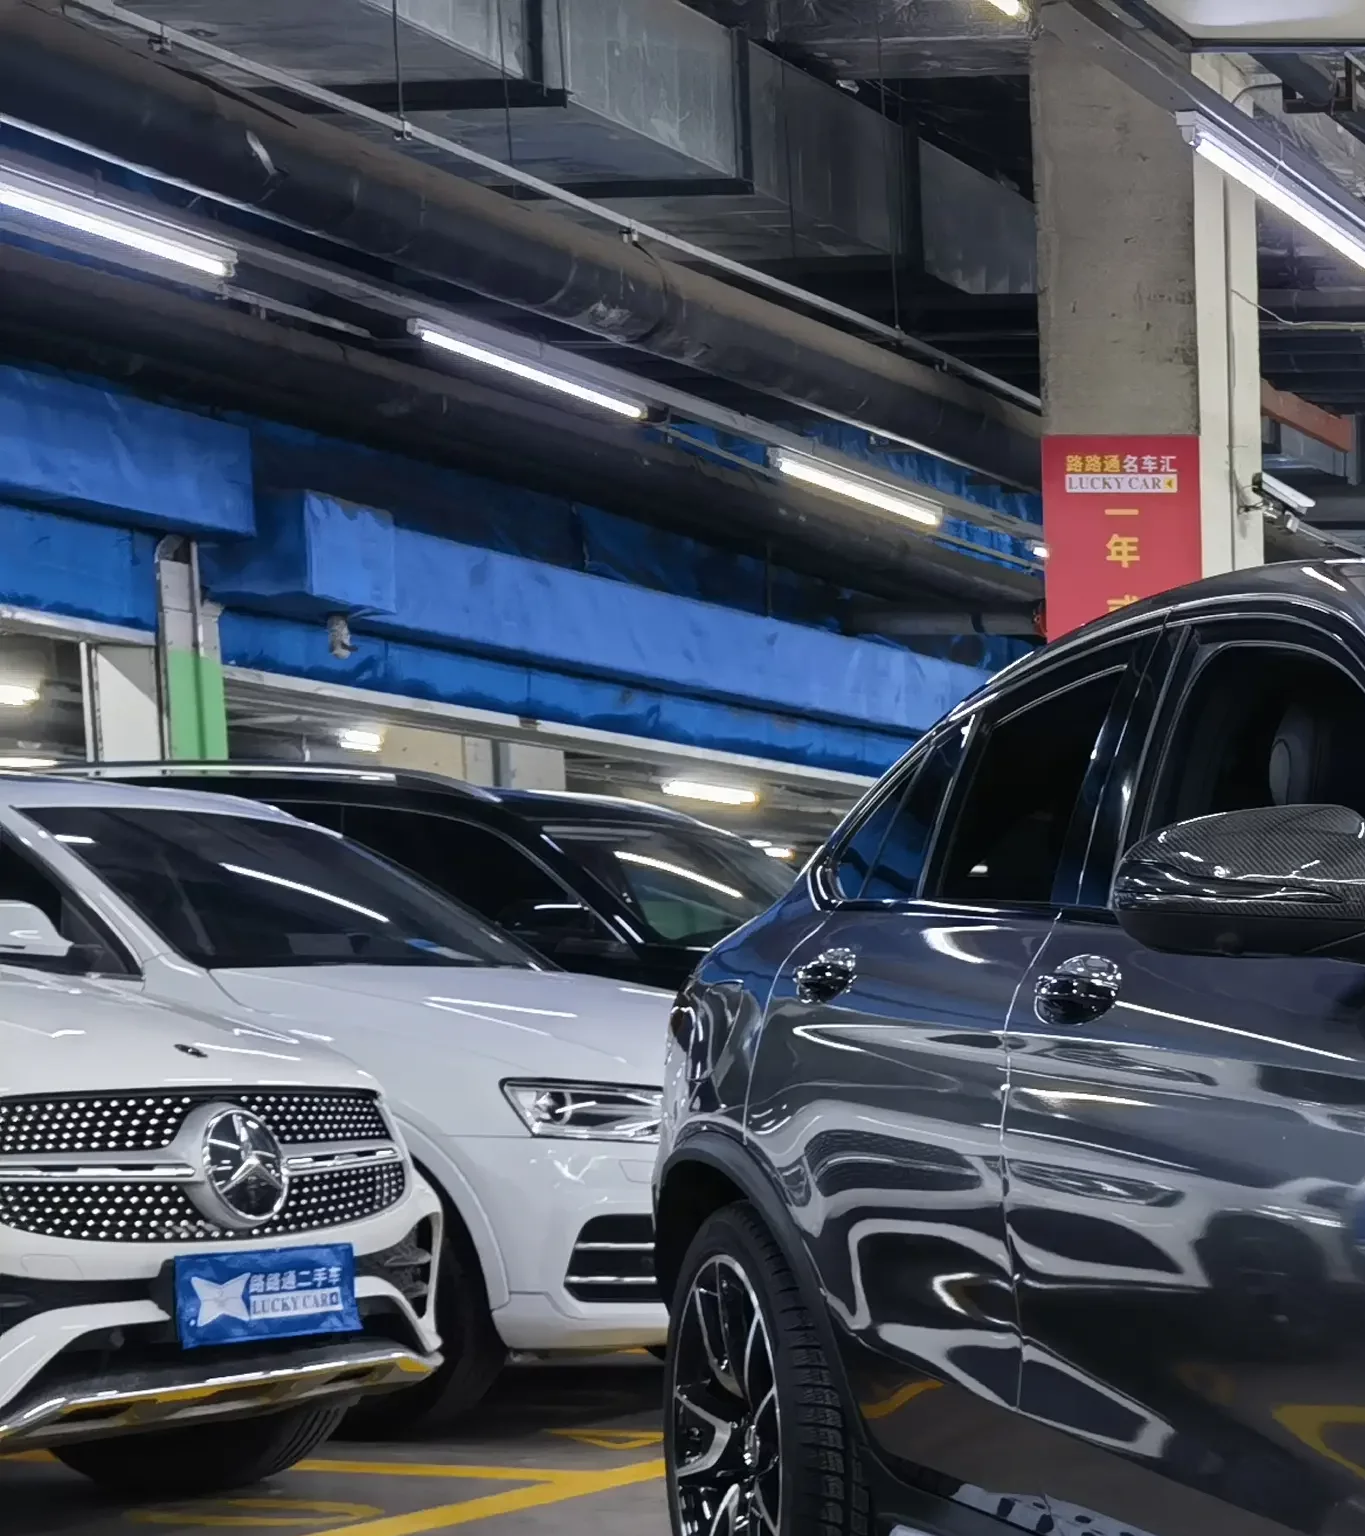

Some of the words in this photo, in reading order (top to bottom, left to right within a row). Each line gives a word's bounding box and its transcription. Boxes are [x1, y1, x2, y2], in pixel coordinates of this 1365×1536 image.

[1066, 454, 1177, 474] 路路通名车汇
[1068, 476, 1124, 490] LUCKY
[1128, 476, 1162, 490] CAR
[252, 1295, 301, 1315] LUCKY
[302, 1292, 328, 1309] CAR
